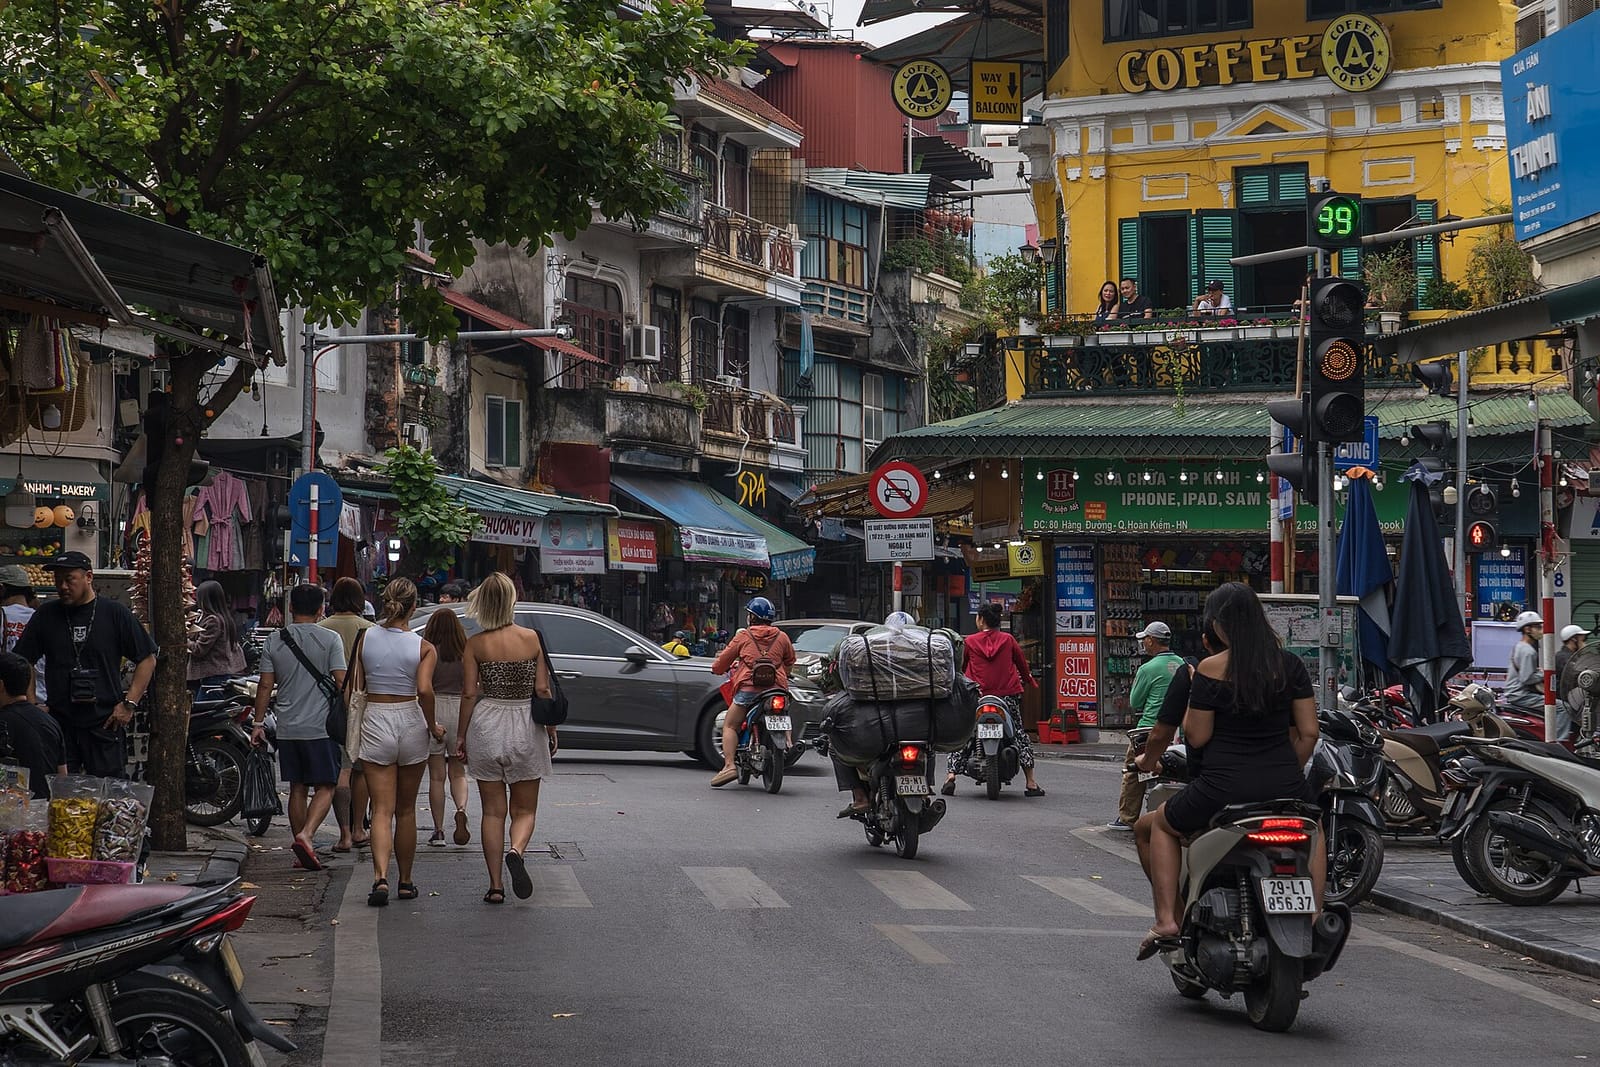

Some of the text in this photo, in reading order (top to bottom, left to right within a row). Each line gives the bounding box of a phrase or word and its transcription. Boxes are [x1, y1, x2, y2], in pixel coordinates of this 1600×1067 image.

[1330, 19, 1381, 41] COFFEE
[902, 64, 944, 81] COFFEE
[1117, 36, 1317, 93] COFFEE
[980, 73, 1002, 83] WAY
[1331, 62, 1382, 87] COFFEE
[984, 86, 998, 96] TO
[903, 98, 943, 113] COFFEE
[975, 102, 1019, 114] BALCONY
[1318, 206, 1352, 235] 39
[61, 484, 96, 497] BAKERY
[738, 470, 767, 509] SPA
[522, 520, 536, 537] VY
[1049, 520, 1059, 529] 80
[1061, 519, 1082, 532] Hàng
[1085, 519, 1113, 531] Đường
[1150, 517, 1171, 529] Kiếm
[1176, 521, 1188, 529] HN
[1059, 640, 1094, 652] ĐIỂM BÁN
[1065, 656, 1090, 676] SIM
[1060, 679, 1097, 697] 4G/5G
[1269, 880, 1306, 895] 29-L1
[1268, 896, 1312, 911] 856.37
